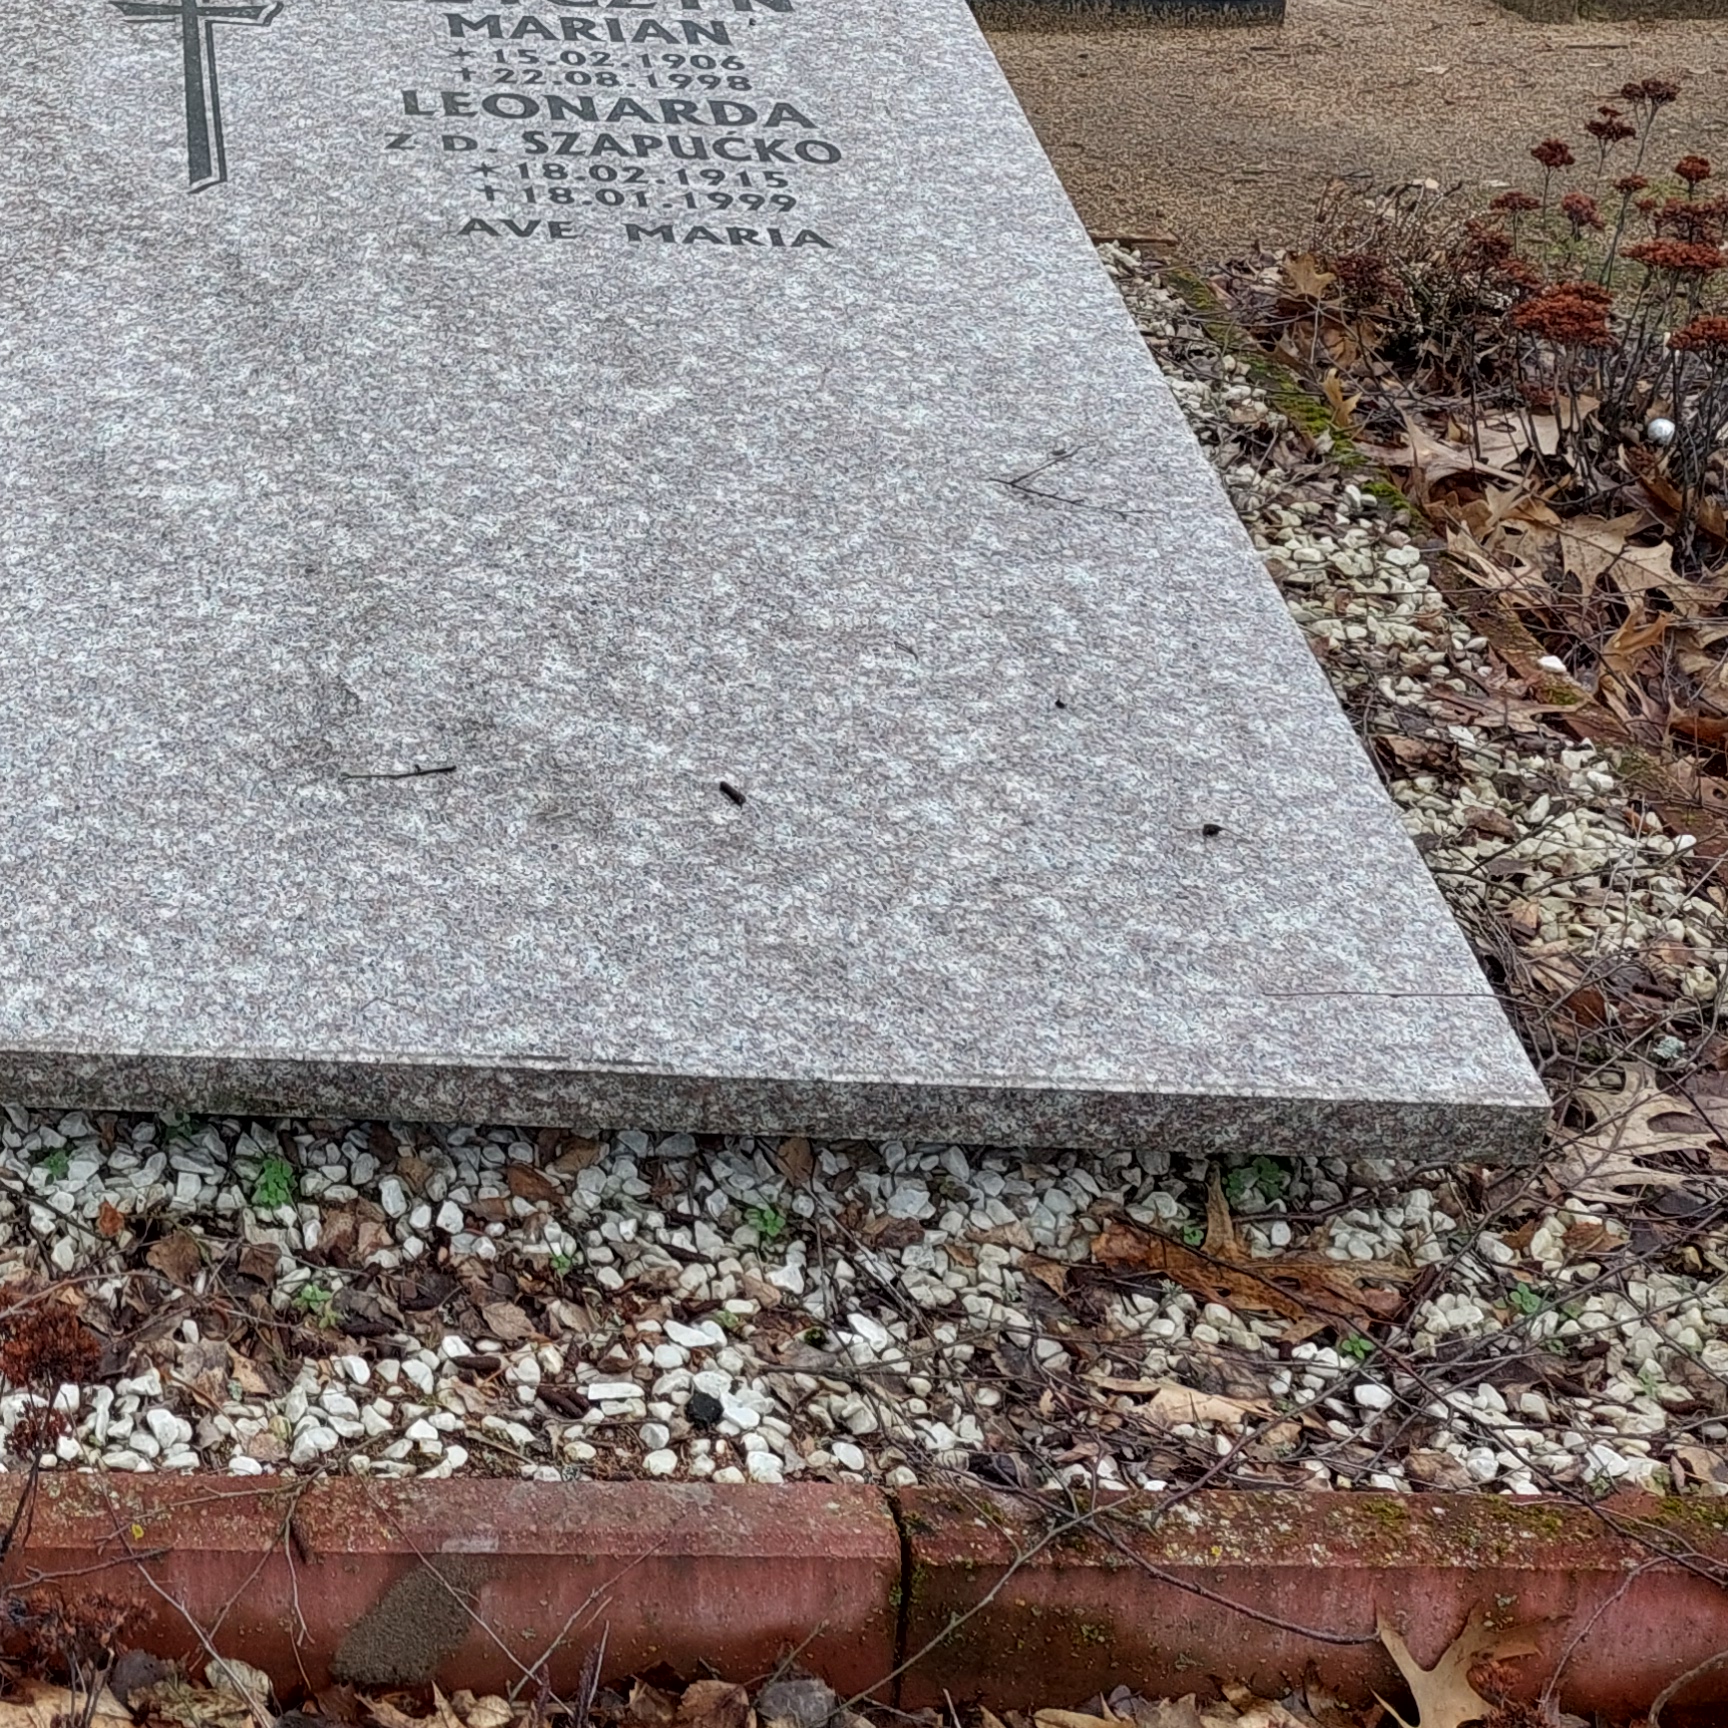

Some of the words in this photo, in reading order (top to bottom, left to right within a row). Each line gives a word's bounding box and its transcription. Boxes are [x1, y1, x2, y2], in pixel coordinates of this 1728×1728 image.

[444, 12, 734, 46] MARIAN
[401, 89, 819, 130] LEONARDA
[383, 132, 417, 152] Z
[521, 129, 843, 165] SZAPUĆKO
[515, 161, 790, 189] 18.02.1915
[522, 187, 798, 212] 18.01.1999
[457, 218, 578, 241] AVE
[623, 222, 838, 250] MARIA
